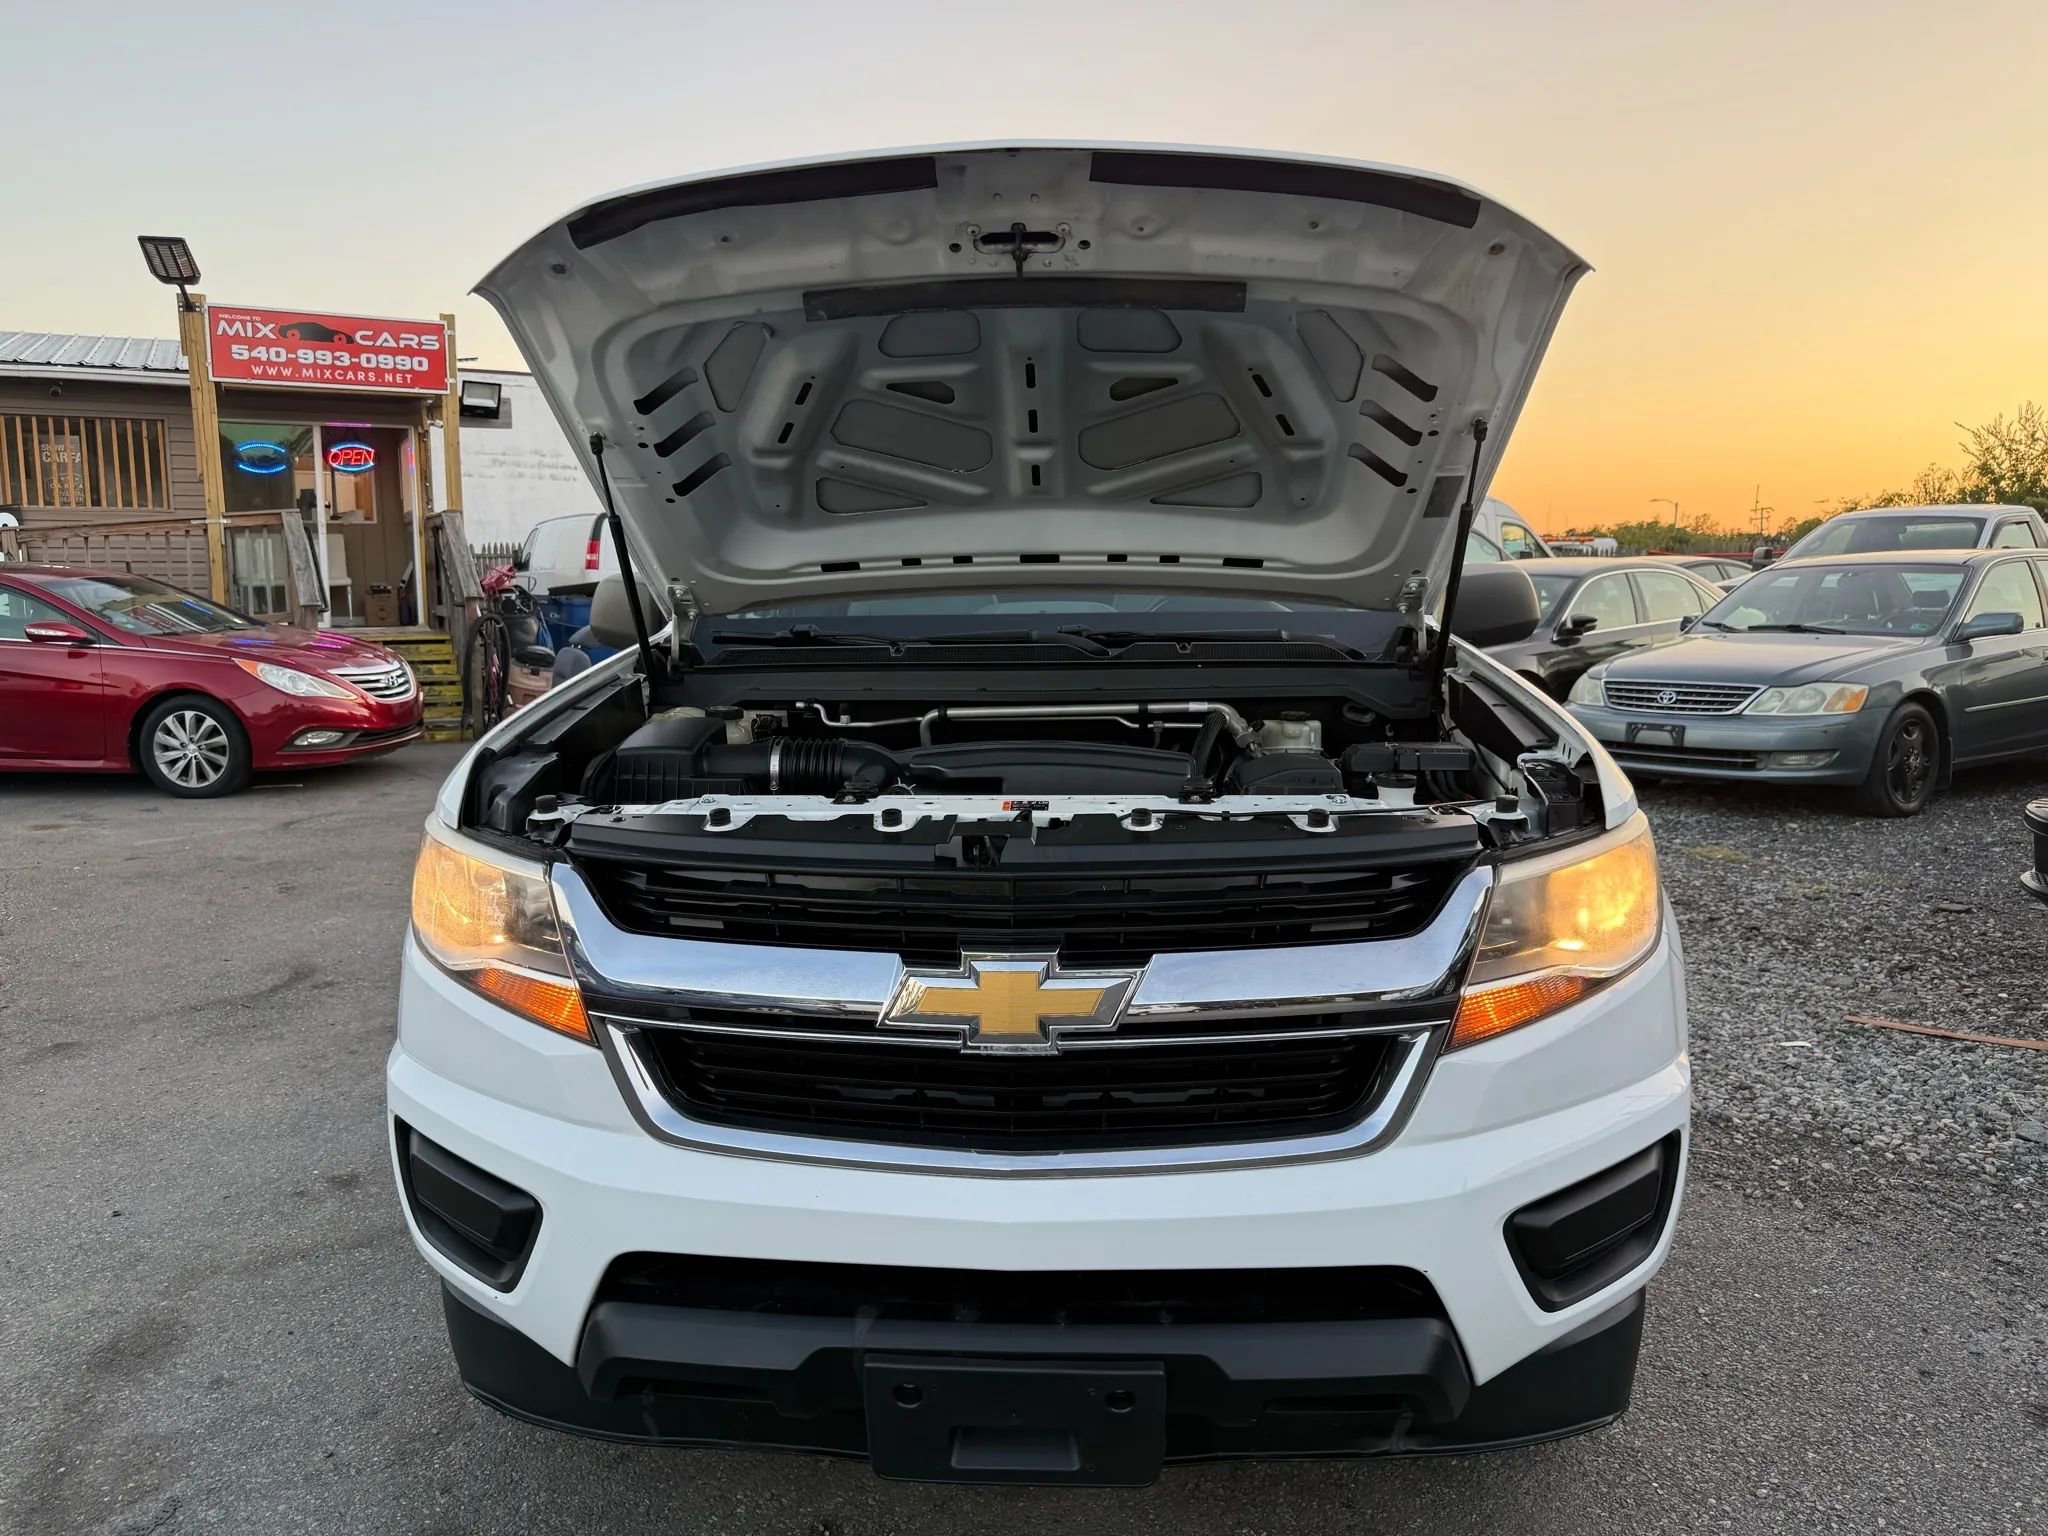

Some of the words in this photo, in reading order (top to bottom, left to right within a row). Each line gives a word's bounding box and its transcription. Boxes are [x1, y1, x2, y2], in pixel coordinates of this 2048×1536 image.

[218, 313, 251, 321] WELCOME
[216, 319, 278, 340] MIX
[354, 330, 440, 350] CARS
[231, 344, 429, 371] 540-993-0990
[251, 364, 413, 384] WWW.MIXCARS.NET
[328, 449, 375, 466] OPEN
